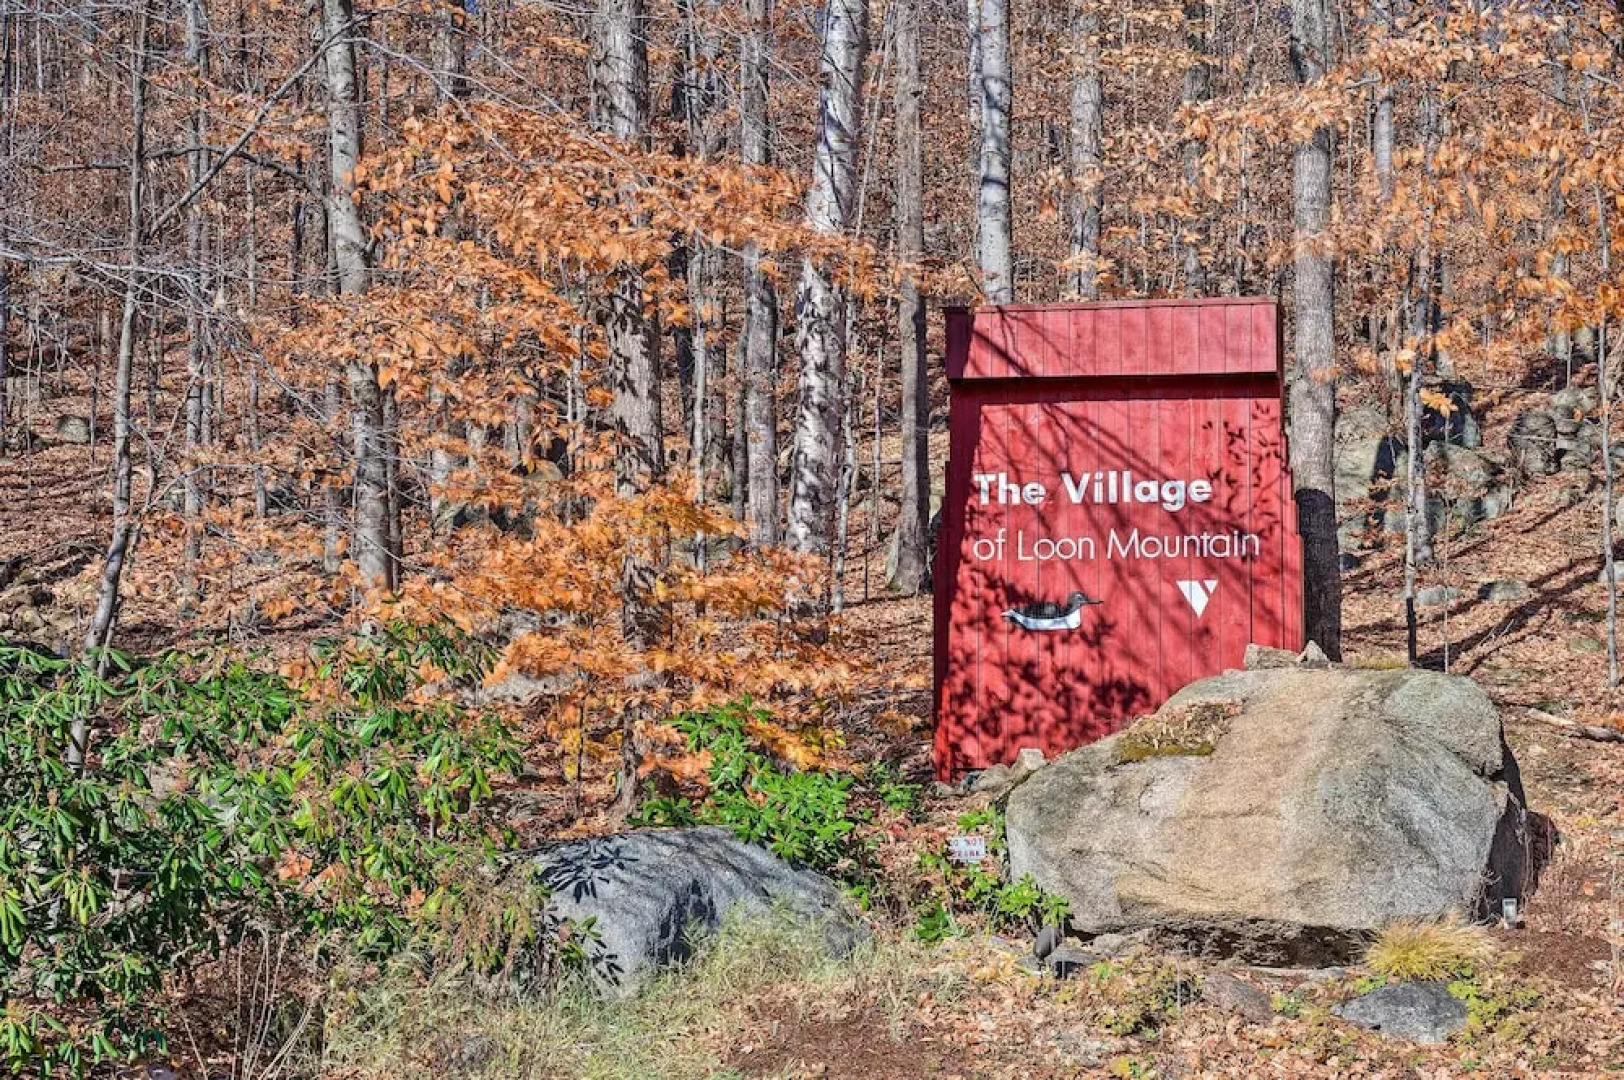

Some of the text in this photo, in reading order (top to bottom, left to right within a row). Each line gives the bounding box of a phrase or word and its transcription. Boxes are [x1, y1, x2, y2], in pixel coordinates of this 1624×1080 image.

[973, 470, 1212, 511] The Village
[973, 528, 1260, 560] of Loon Mountain
